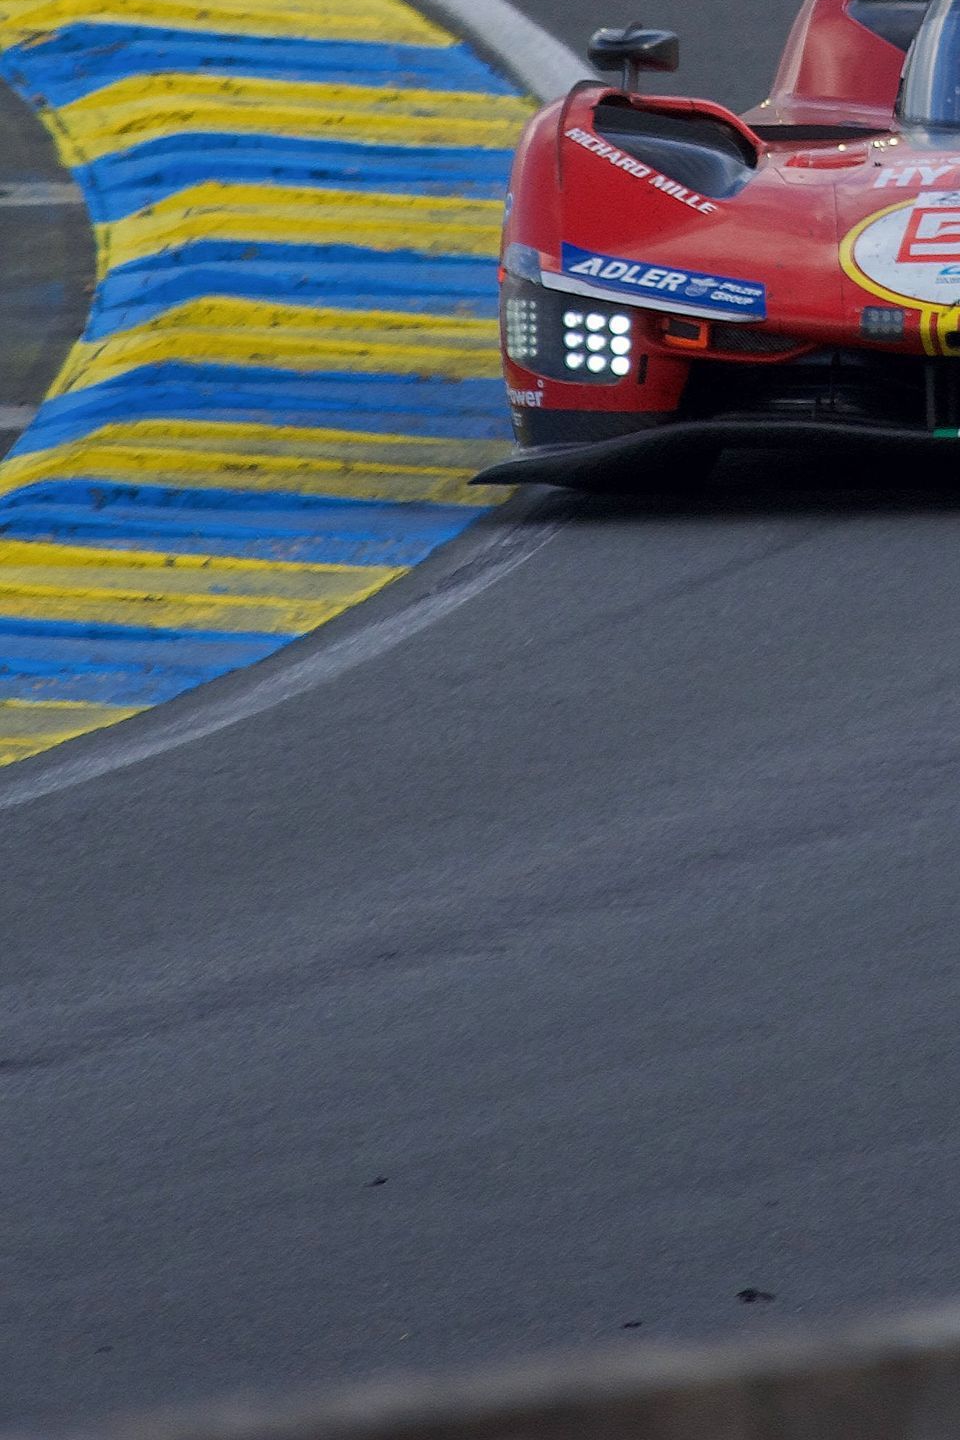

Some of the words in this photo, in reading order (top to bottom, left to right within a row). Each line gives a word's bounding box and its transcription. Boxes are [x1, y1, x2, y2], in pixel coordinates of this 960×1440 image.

[565, 127, 651, 178] RICHARD
[649, 175, 717, 215] MILLE
[569, 257, 688, 291] ADLER
